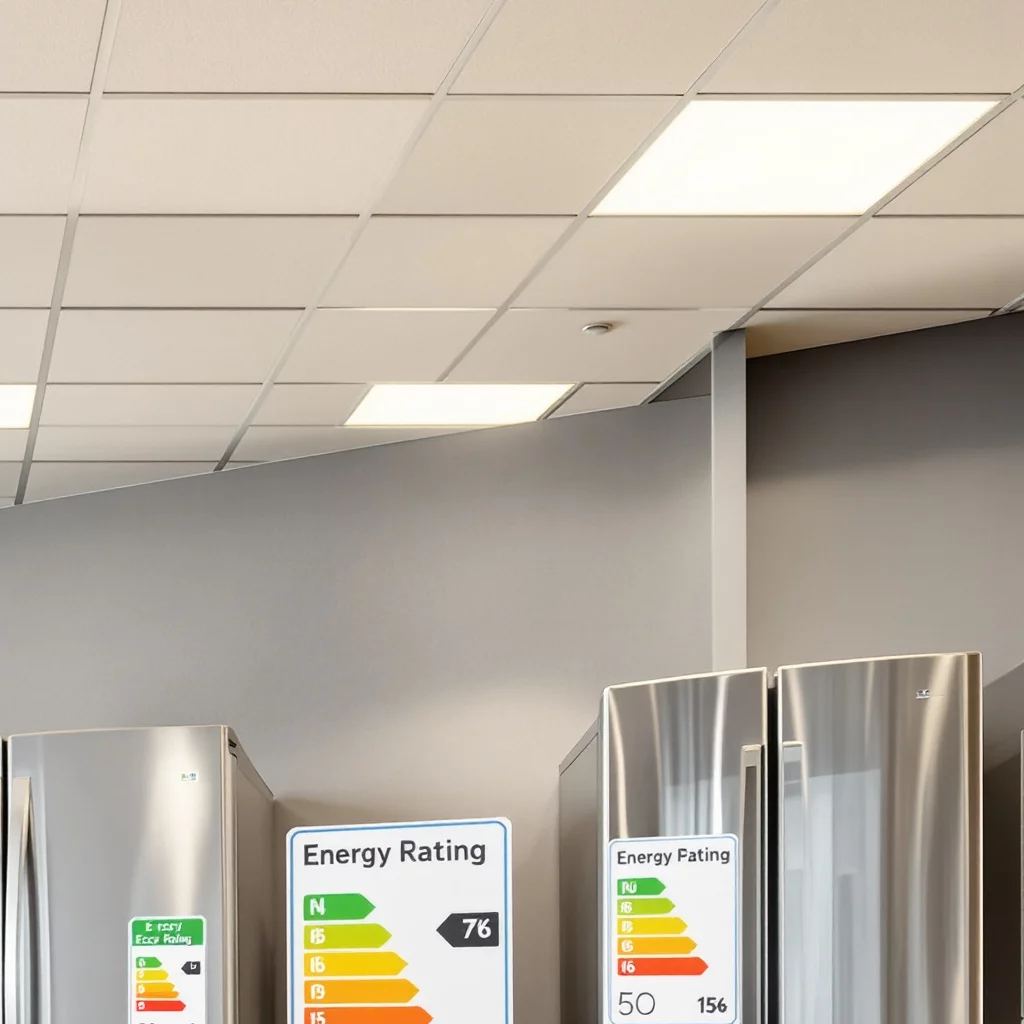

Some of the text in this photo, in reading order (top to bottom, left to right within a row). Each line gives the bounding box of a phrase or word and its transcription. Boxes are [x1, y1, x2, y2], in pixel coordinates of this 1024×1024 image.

[303, 839, 486, 868] Energy Rating
[617, 850, 672, 867] Energy
[618, 991, 656, 1016] 50
